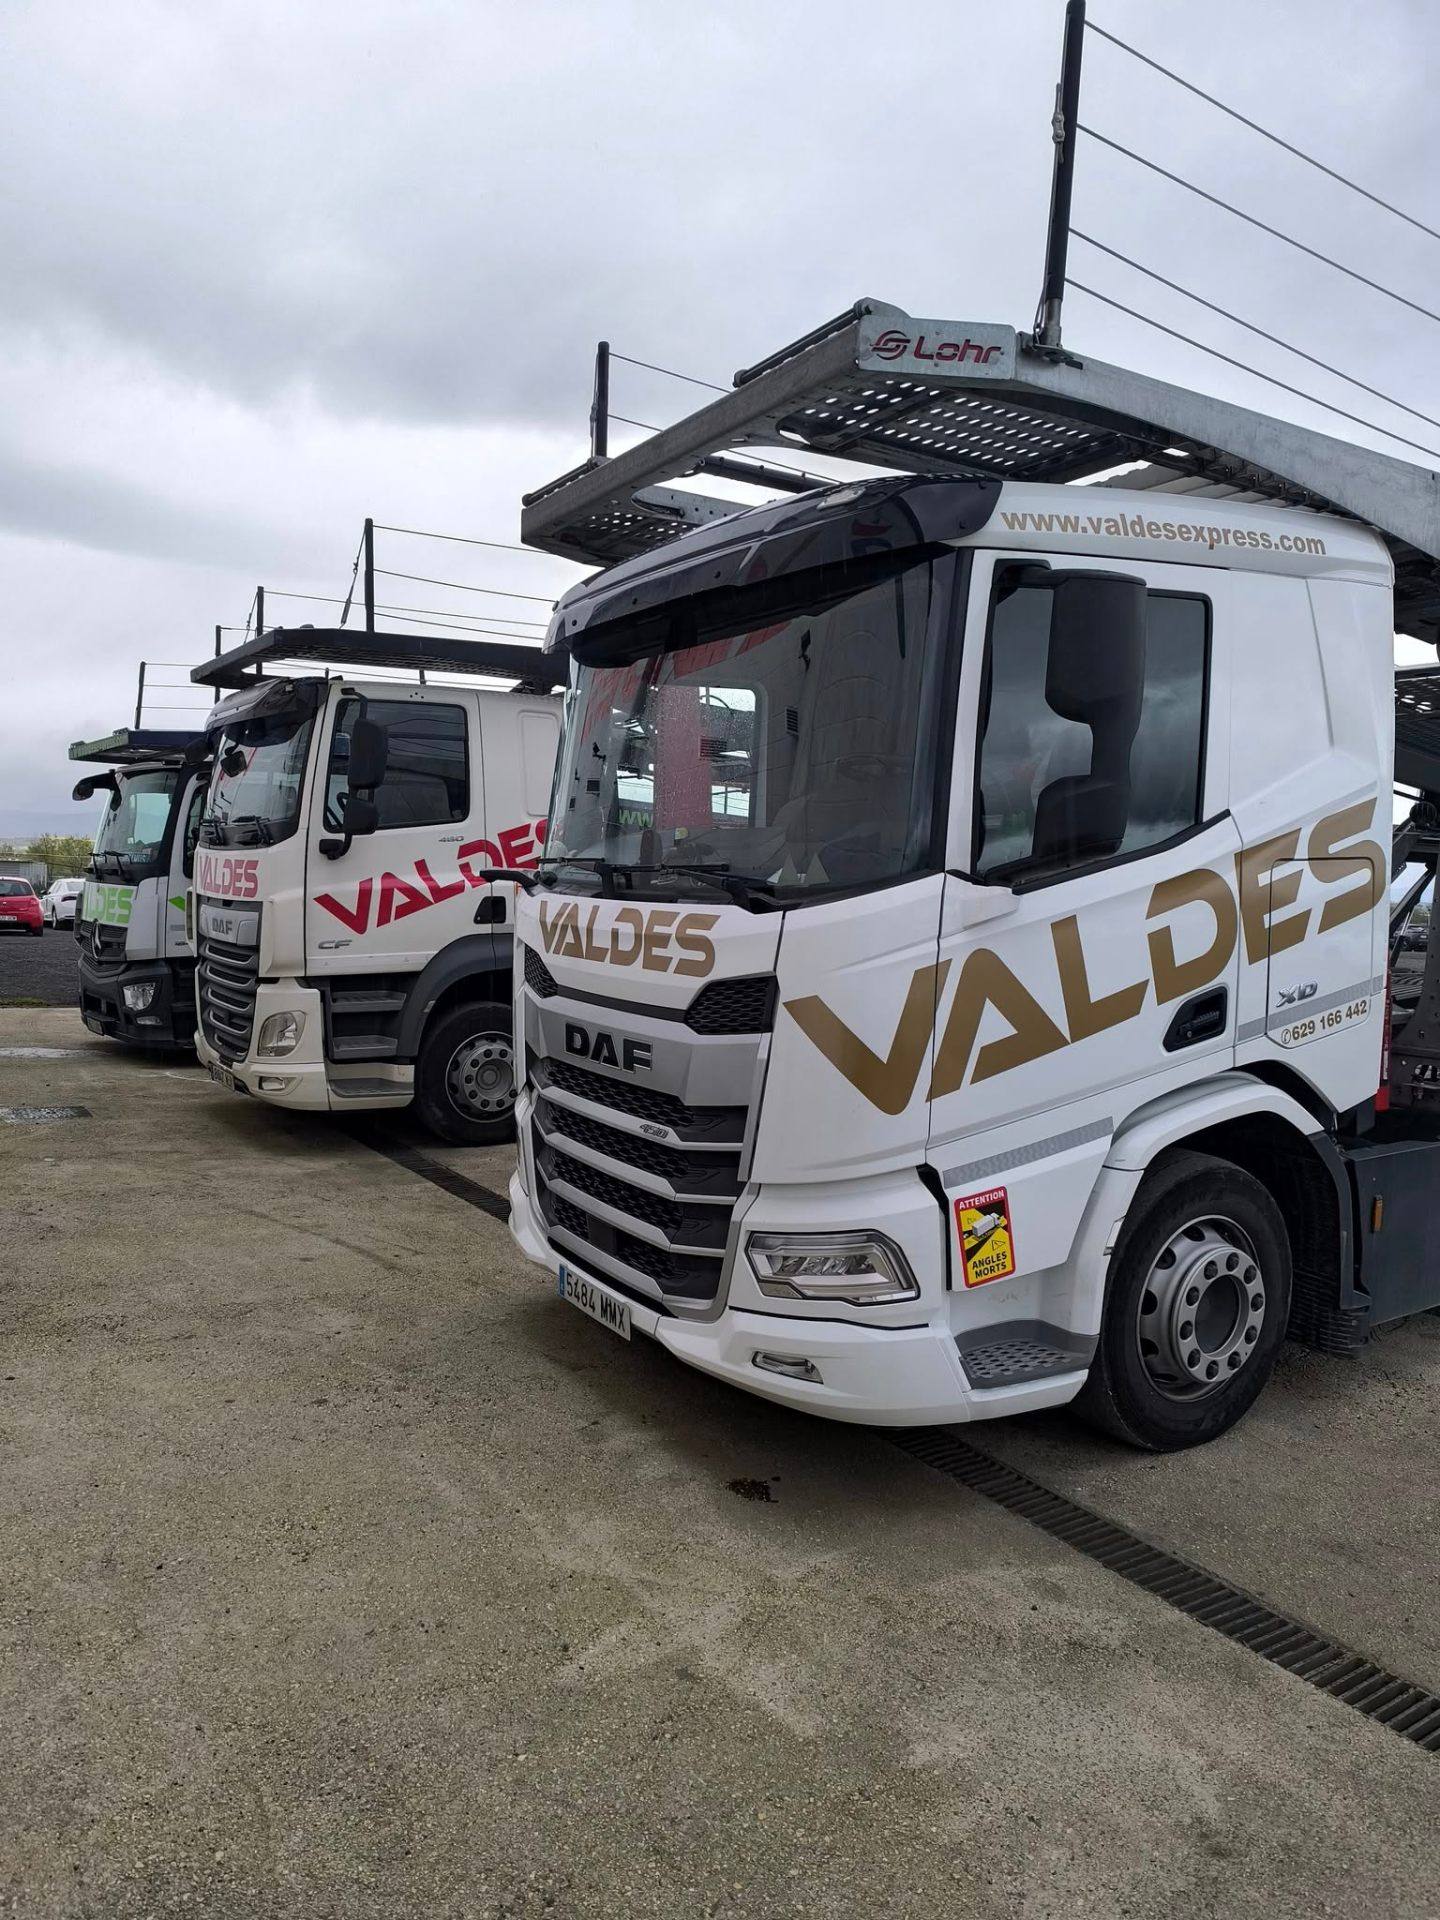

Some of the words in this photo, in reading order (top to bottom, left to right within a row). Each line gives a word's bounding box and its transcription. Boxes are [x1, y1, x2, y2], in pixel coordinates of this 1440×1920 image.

[913, 335, 1001, 364] Lohr
[1001, 511, 1327, 555] www.valdesexpress.com
[199, 855, 259, 898] VALDES
[211, 917, 233, 935] DAF
[539, 900, 721, 978] VALDES
[318, 938, 353, 950] CF
[782, 797, 1386, 1115] VALDES
[1275, 980, 1318, 1008] XD
[1291, 1020, 1316, 1041] 629
[1319, 1010, 1342, 1030] 166
[1345, 999, 1368, 1020] 442
[564, 1022, 653, 1074] DAF
[959, 1189, 1005, 1210] ATTENTION
[972, 1251, 1008, 1271] ANGLES
[974, 1261, 1008, 1280] MORTS
[566, 1271, 596, 1313] 5484
[600, 1292, 626, 1333] MMX
